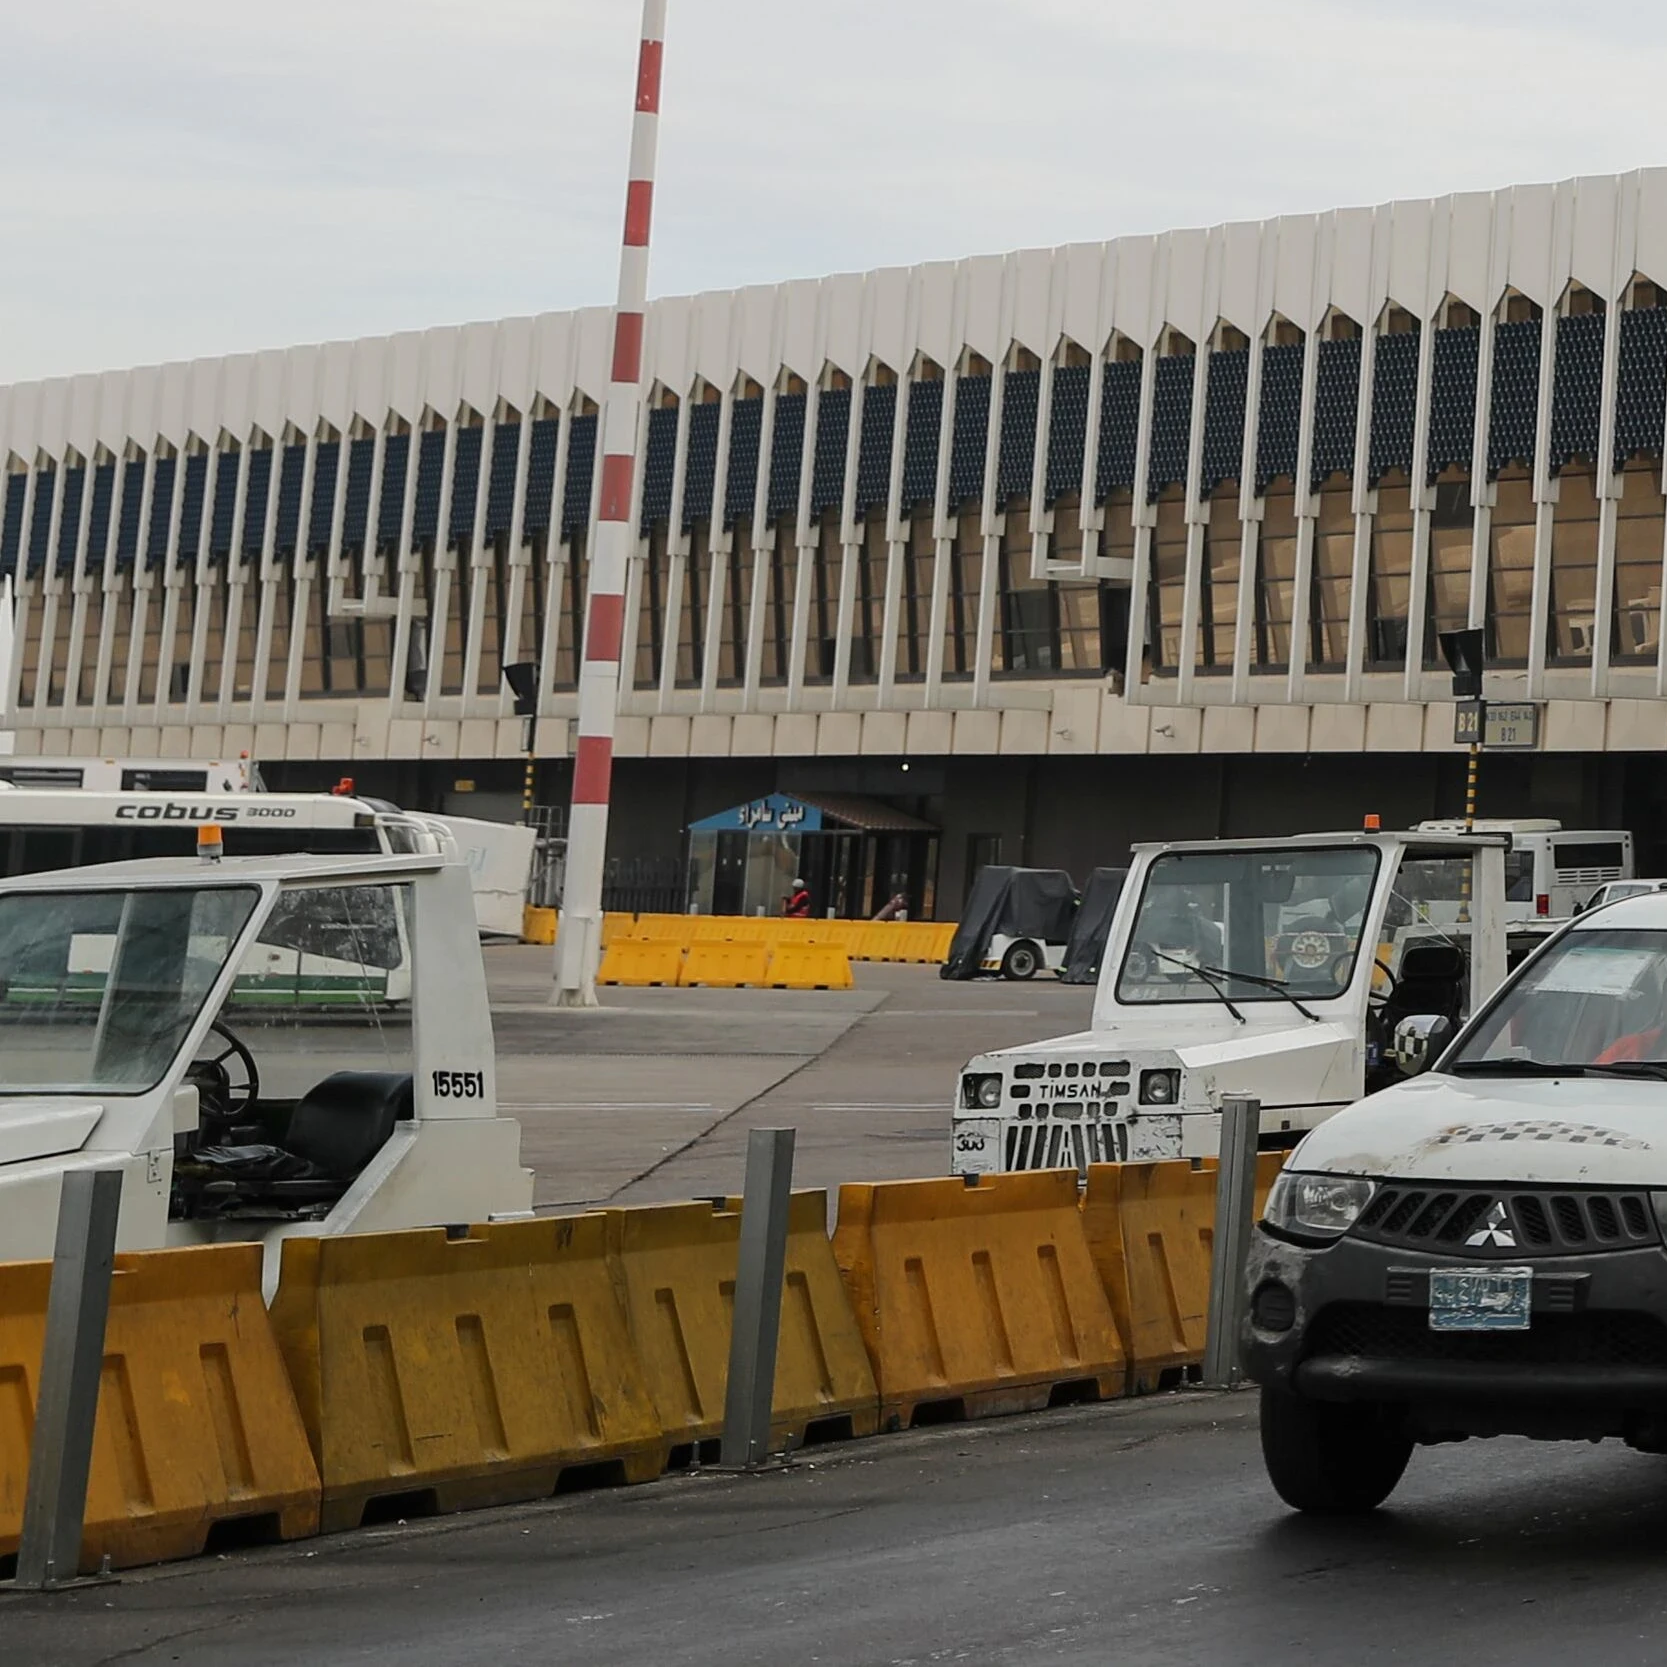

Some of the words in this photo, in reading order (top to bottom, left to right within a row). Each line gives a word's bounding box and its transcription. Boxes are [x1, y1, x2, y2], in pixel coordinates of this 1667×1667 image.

[1458, 712, 1466, 732] B
[1467, 711, 1478, 732] 21
[115, 802, 241, 821] cobus
[246, 807, 296, 818] 3000
[432, 1070, 484, 1099] 15551
